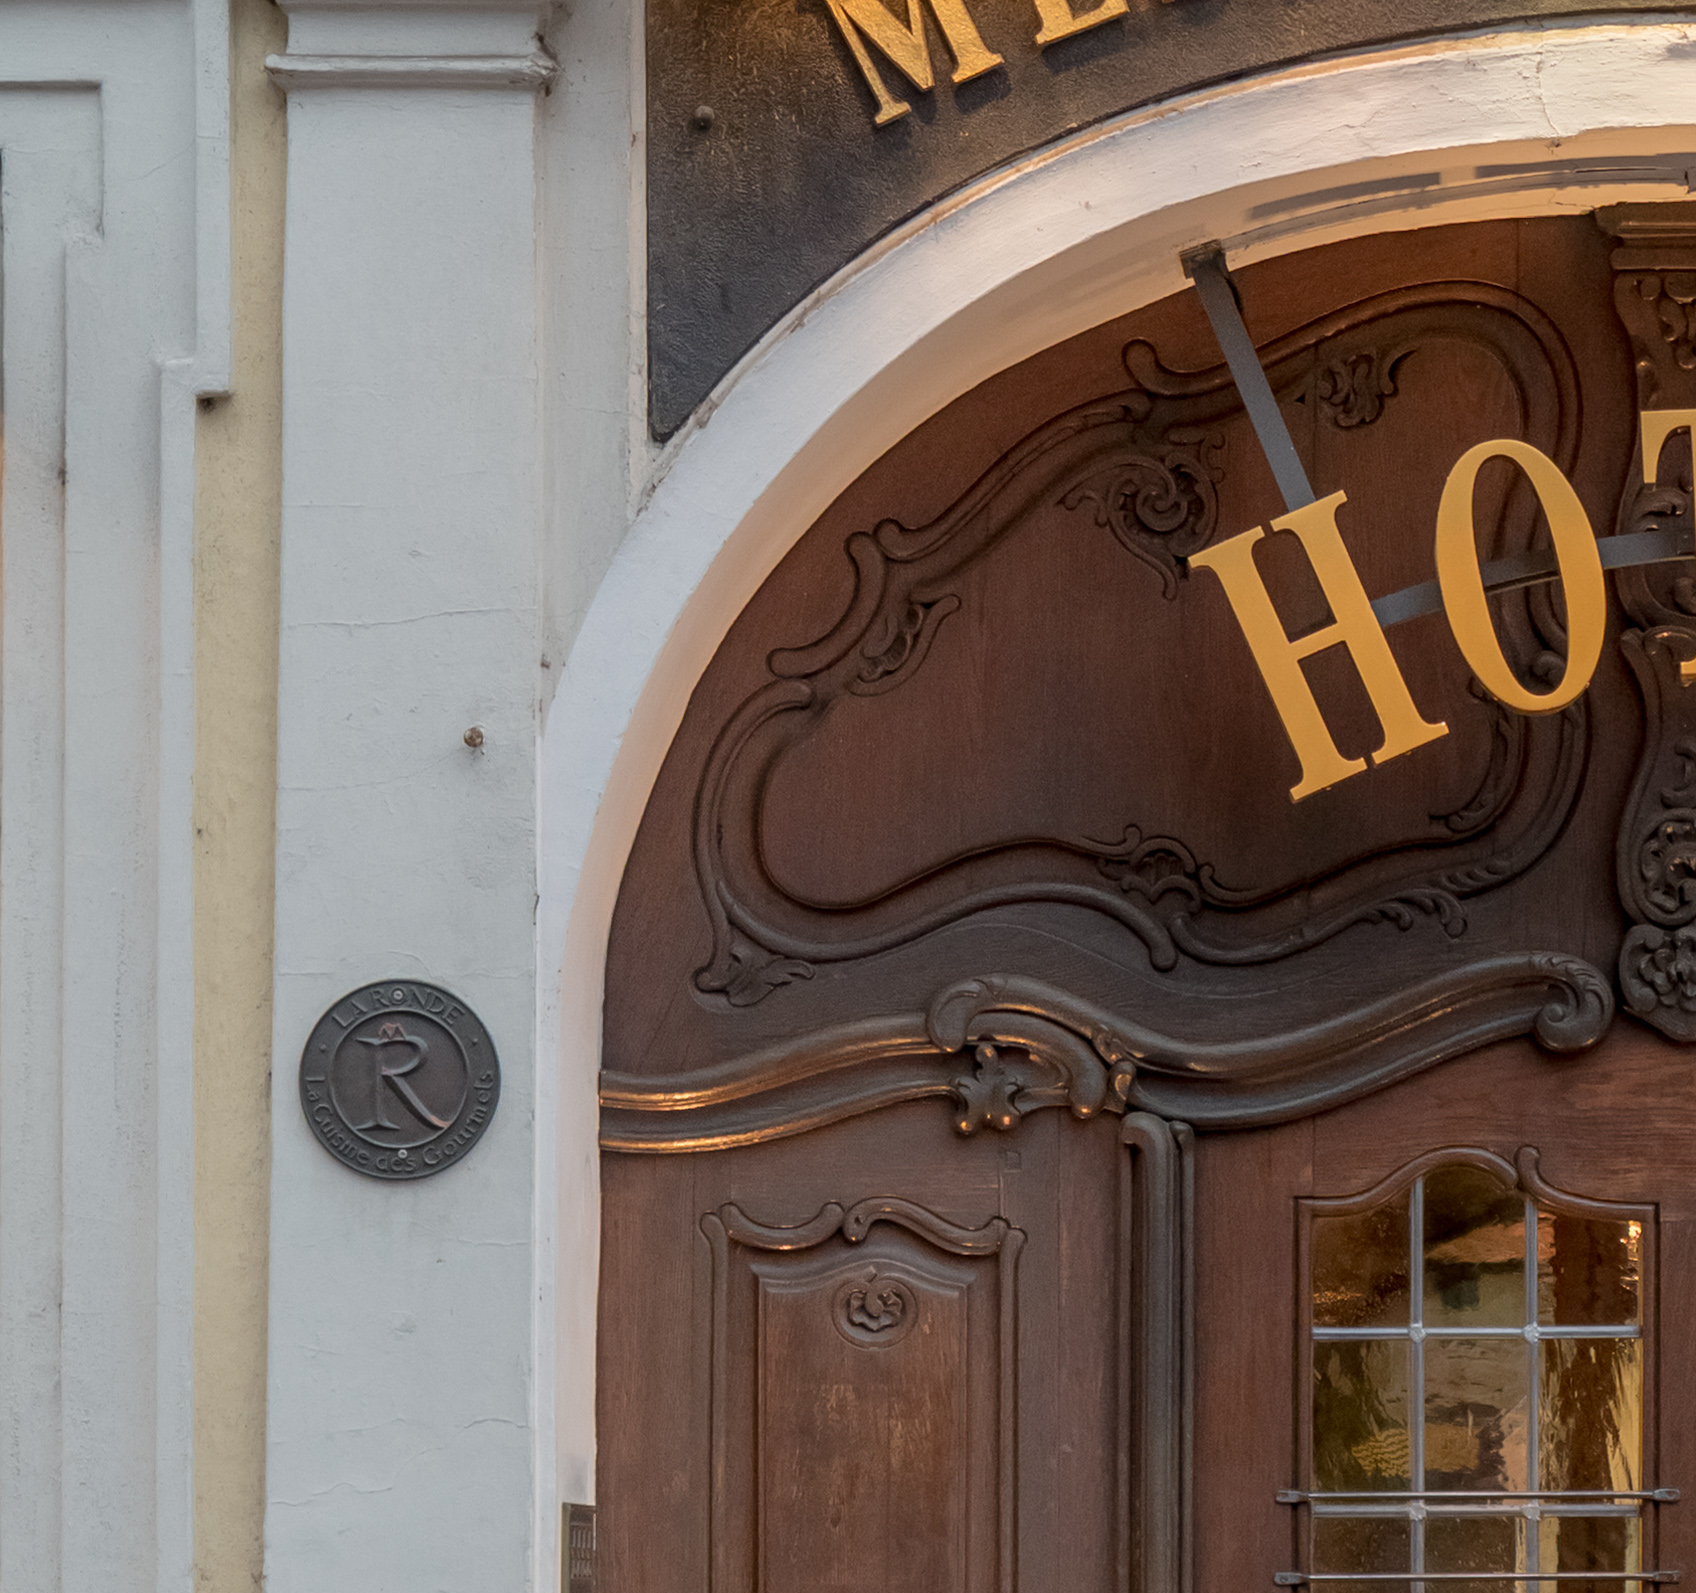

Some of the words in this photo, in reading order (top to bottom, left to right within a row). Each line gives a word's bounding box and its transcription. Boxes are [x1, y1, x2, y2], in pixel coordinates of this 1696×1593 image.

[331, 1002, 367, 1028] LA
[370, 986, 466, 1026] RONDE
[305, 1074, 325, 1102] La
[355, 1032, 453, 1132] R
[313, 1103, 371, 1166] Cuisine
[422, 1071, 494, 1165] Gourmets
[376, 1152, 417, 1173] des
